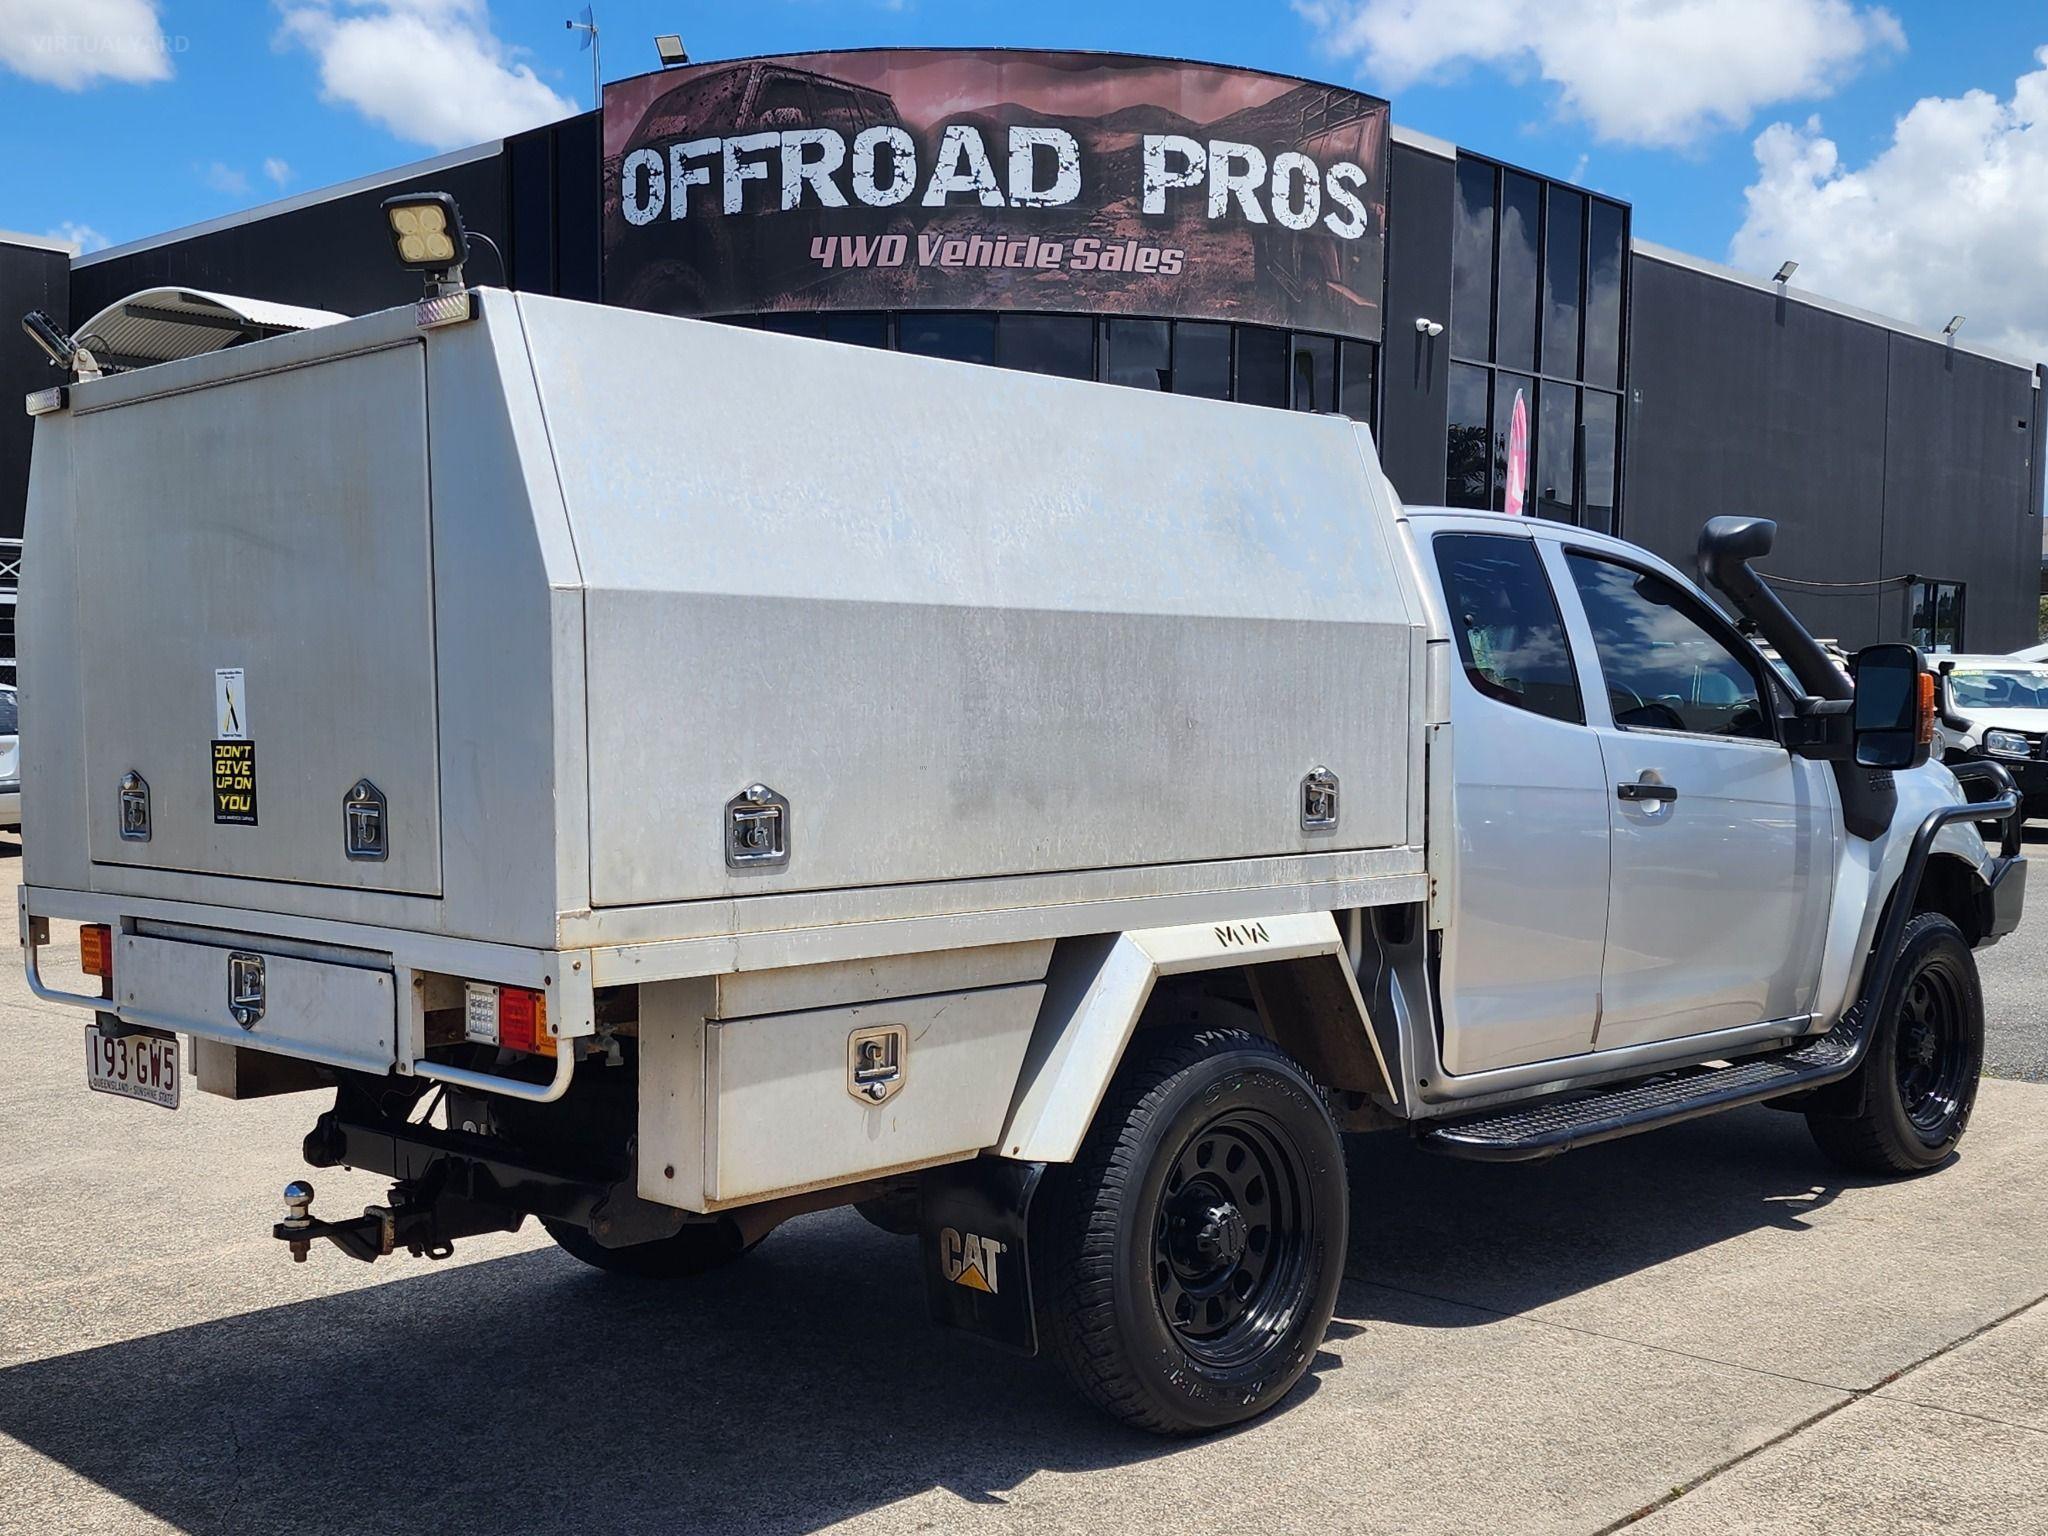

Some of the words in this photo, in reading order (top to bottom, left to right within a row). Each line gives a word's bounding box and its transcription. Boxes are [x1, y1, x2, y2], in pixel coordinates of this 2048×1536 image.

[620, 125, 1082, 228] OFFROAD
[1142, 133, 1368, 240] PROS
[809, 235, 908, 270] 4WD
[913, 233, 1064, 270] Vehicle
[1068, 237, 1185, 276] Sales
[214, 745, 252, 759] DON'T
[215, 760, 252, 775] GIVE
[216, 776, 233, 789] UP
[234, 777, 252, 790] ON
[219, 795, 251, 811] YOU
[93, 1078, 129, 1093] QUEENSLAND
[159, 1091, 174, 1105] STATE
[940, 1227, 1001, 1294] CAT
